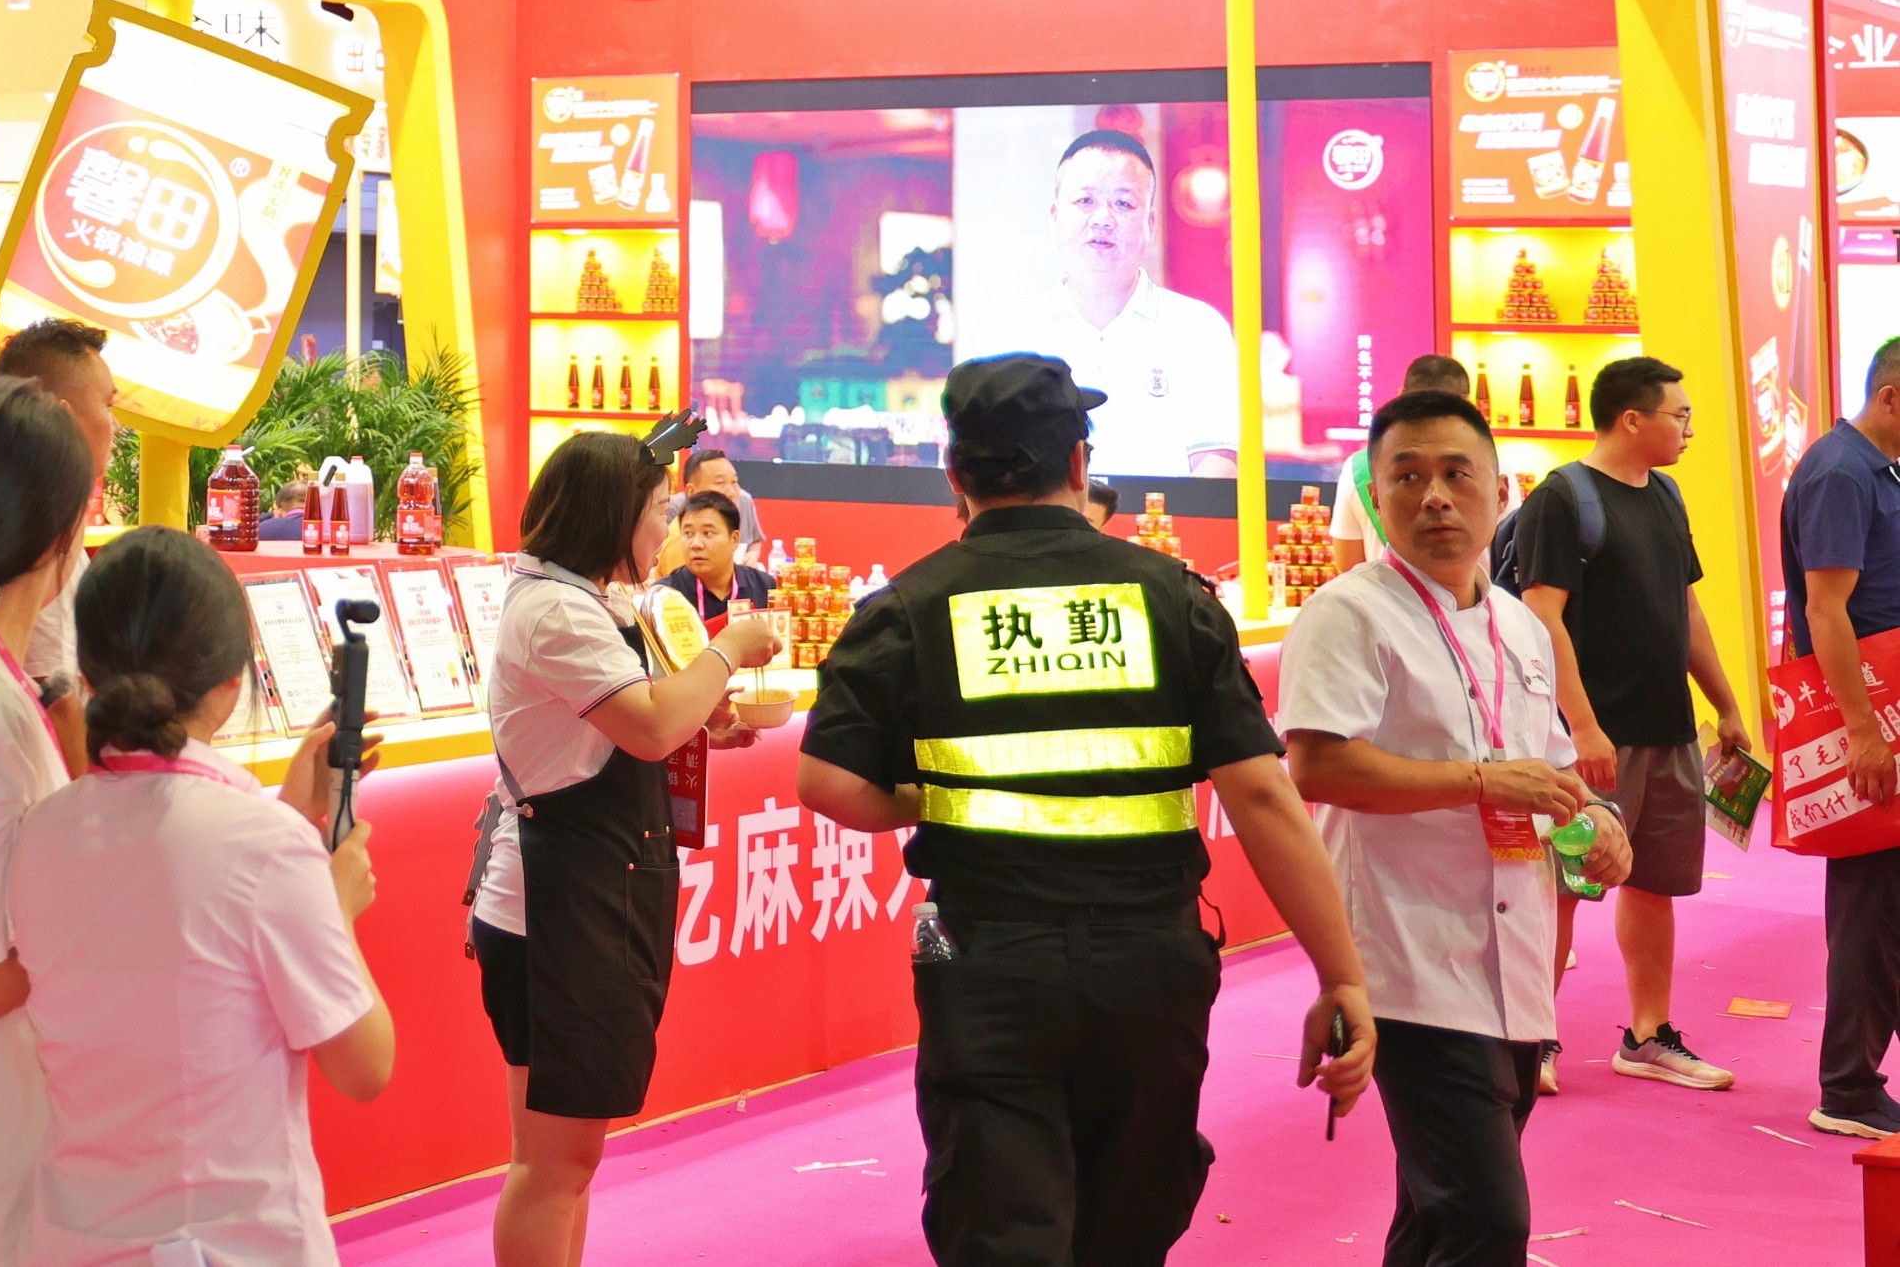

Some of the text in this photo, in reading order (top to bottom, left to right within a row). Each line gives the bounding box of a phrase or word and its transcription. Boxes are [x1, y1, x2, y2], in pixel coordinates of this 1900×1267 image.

[1828, 23, 1900, 70] 业
[65, 144, 210, 253] 馨田
[65, 215, 176, 279] 火锅油碟
[981, 599, 1122, 650] 执勤
[986, 649, 1127, 676] ZHIQIN
[1798, 661, 1884, 708] 牛道
